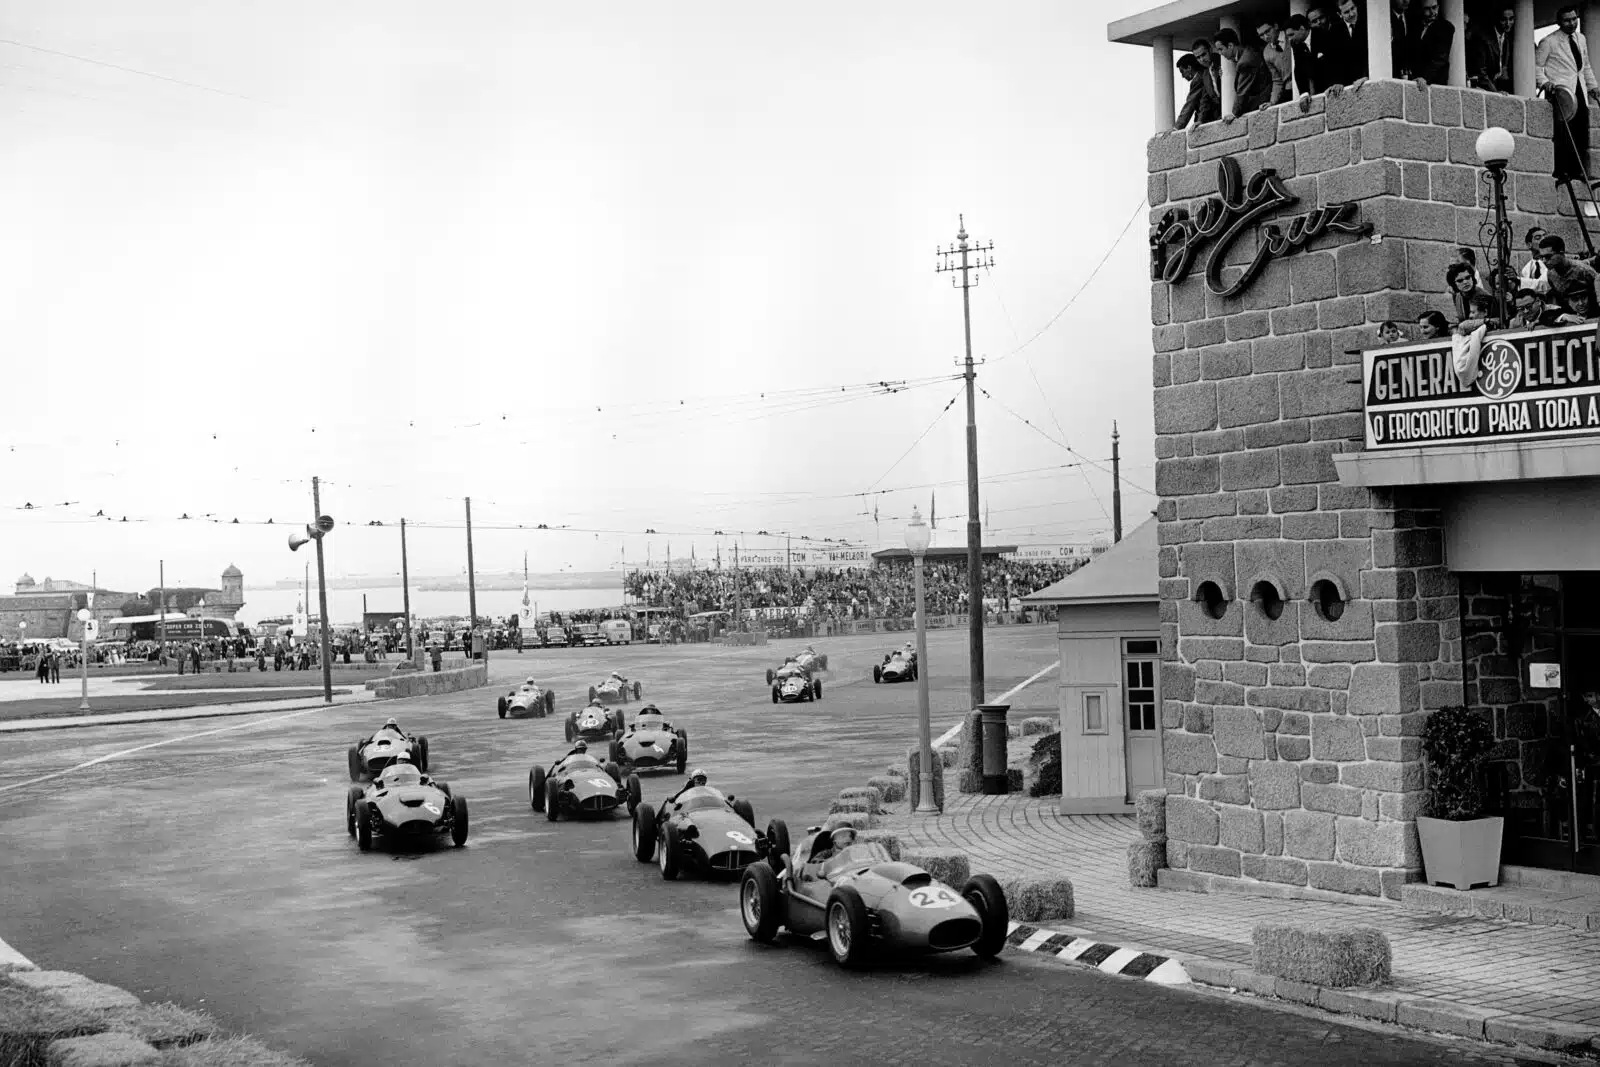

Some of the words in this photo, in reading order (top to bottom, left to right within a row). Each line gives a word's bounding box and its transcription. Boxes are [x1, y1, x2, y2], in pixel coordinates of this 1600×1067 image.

[1205, 198, 1375, 297] Cruz
[1523, 335, 1600, 388] ELECT
[1373, 414, 1385, 442] O
[1389, 406, 1480, 441] FRIGORIFICO
[1488, 401, 1532, 433] PARA
[1535, 397, 1582, 430] TODA
[1586, 395, 1600, 426] A
[1059, 547, 1075, 556] COM
[424, 802, 441, 815] 6
[726, 830, 753, 845] 8
[911, 889, 957, 907] 24
